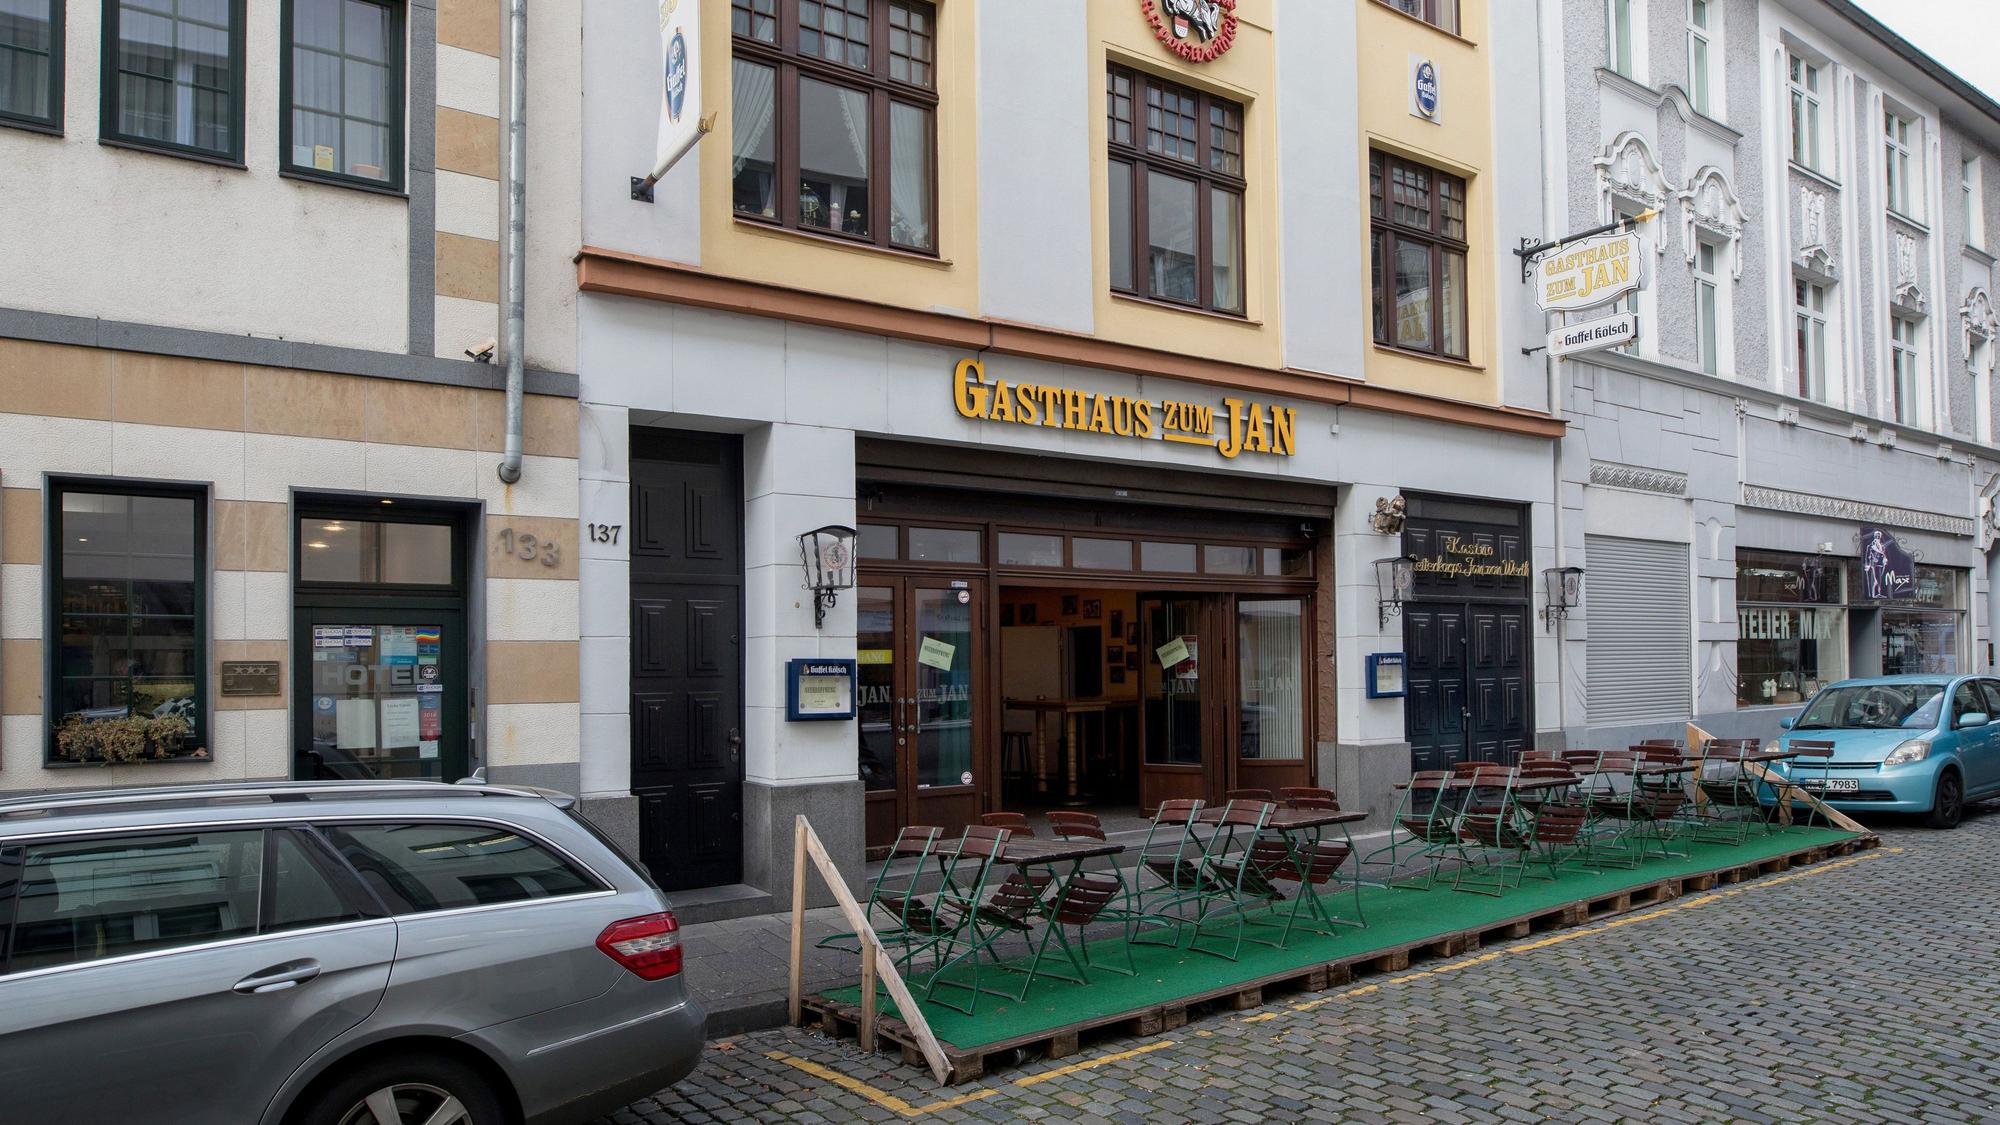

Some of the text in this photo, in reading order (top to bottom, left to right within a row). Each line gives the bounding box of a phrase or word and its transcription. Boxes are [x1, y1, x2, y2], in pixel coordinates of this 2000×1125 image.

[1545, 238, 1630, 276] GASTHAUS
[1546, 256, 1630, 298] ZUM JAN
[1564, 321, 1629, 346] Gaffel Kölsch
[953, 357, 1296, 458] GASTHAUS ZUM JAN
[587, 522, 622, 545] 137
[499, 527, 560, 567] 133
[1446, 536, 1493, 556] Kasino
[1885, 570, 1910, 592] Max
[1736, 608, 1832, 640] TELIER MAX
[321, 665, 433, 686] HOTEL
[810, 665, 828, 674] Gaffel
[858, 685, 891, 707] JAN
[917, 684, 969, 704] ZUM JAN
[1169, 679, 1195, 696] JAN
[1832, 780, 1857, 789] 7983
